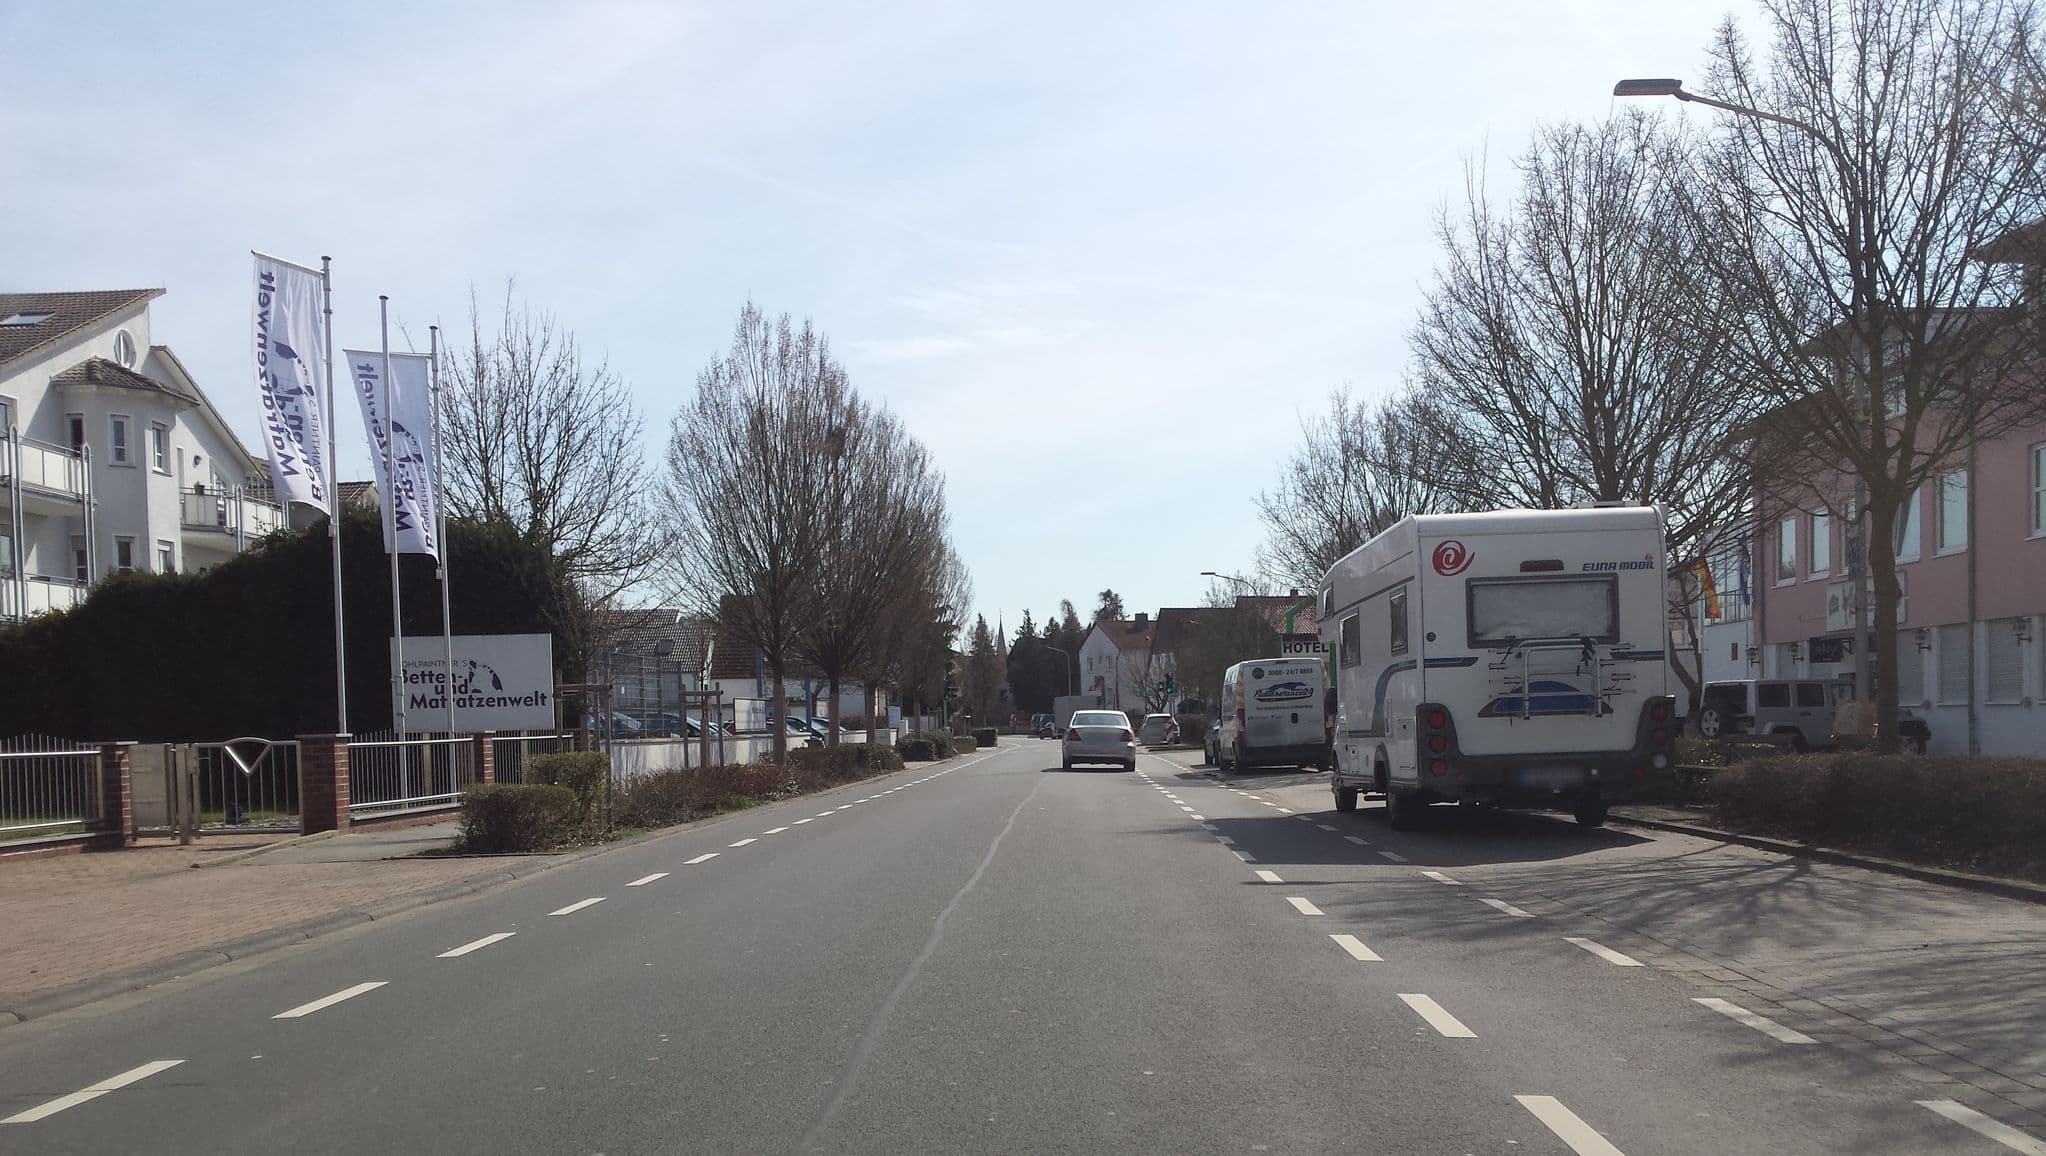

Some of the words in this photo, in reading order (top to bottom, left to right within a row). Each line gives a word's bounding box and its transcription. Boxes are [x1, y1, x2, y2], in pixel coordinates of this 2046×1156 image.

[1582, 562, 1617, 572] EURA
[1619, 560, 1655, 570] MOBIL
[1283, 642, 1329, 654] HOTEL
[409, 690, 548, 709] Matatzenwelt
